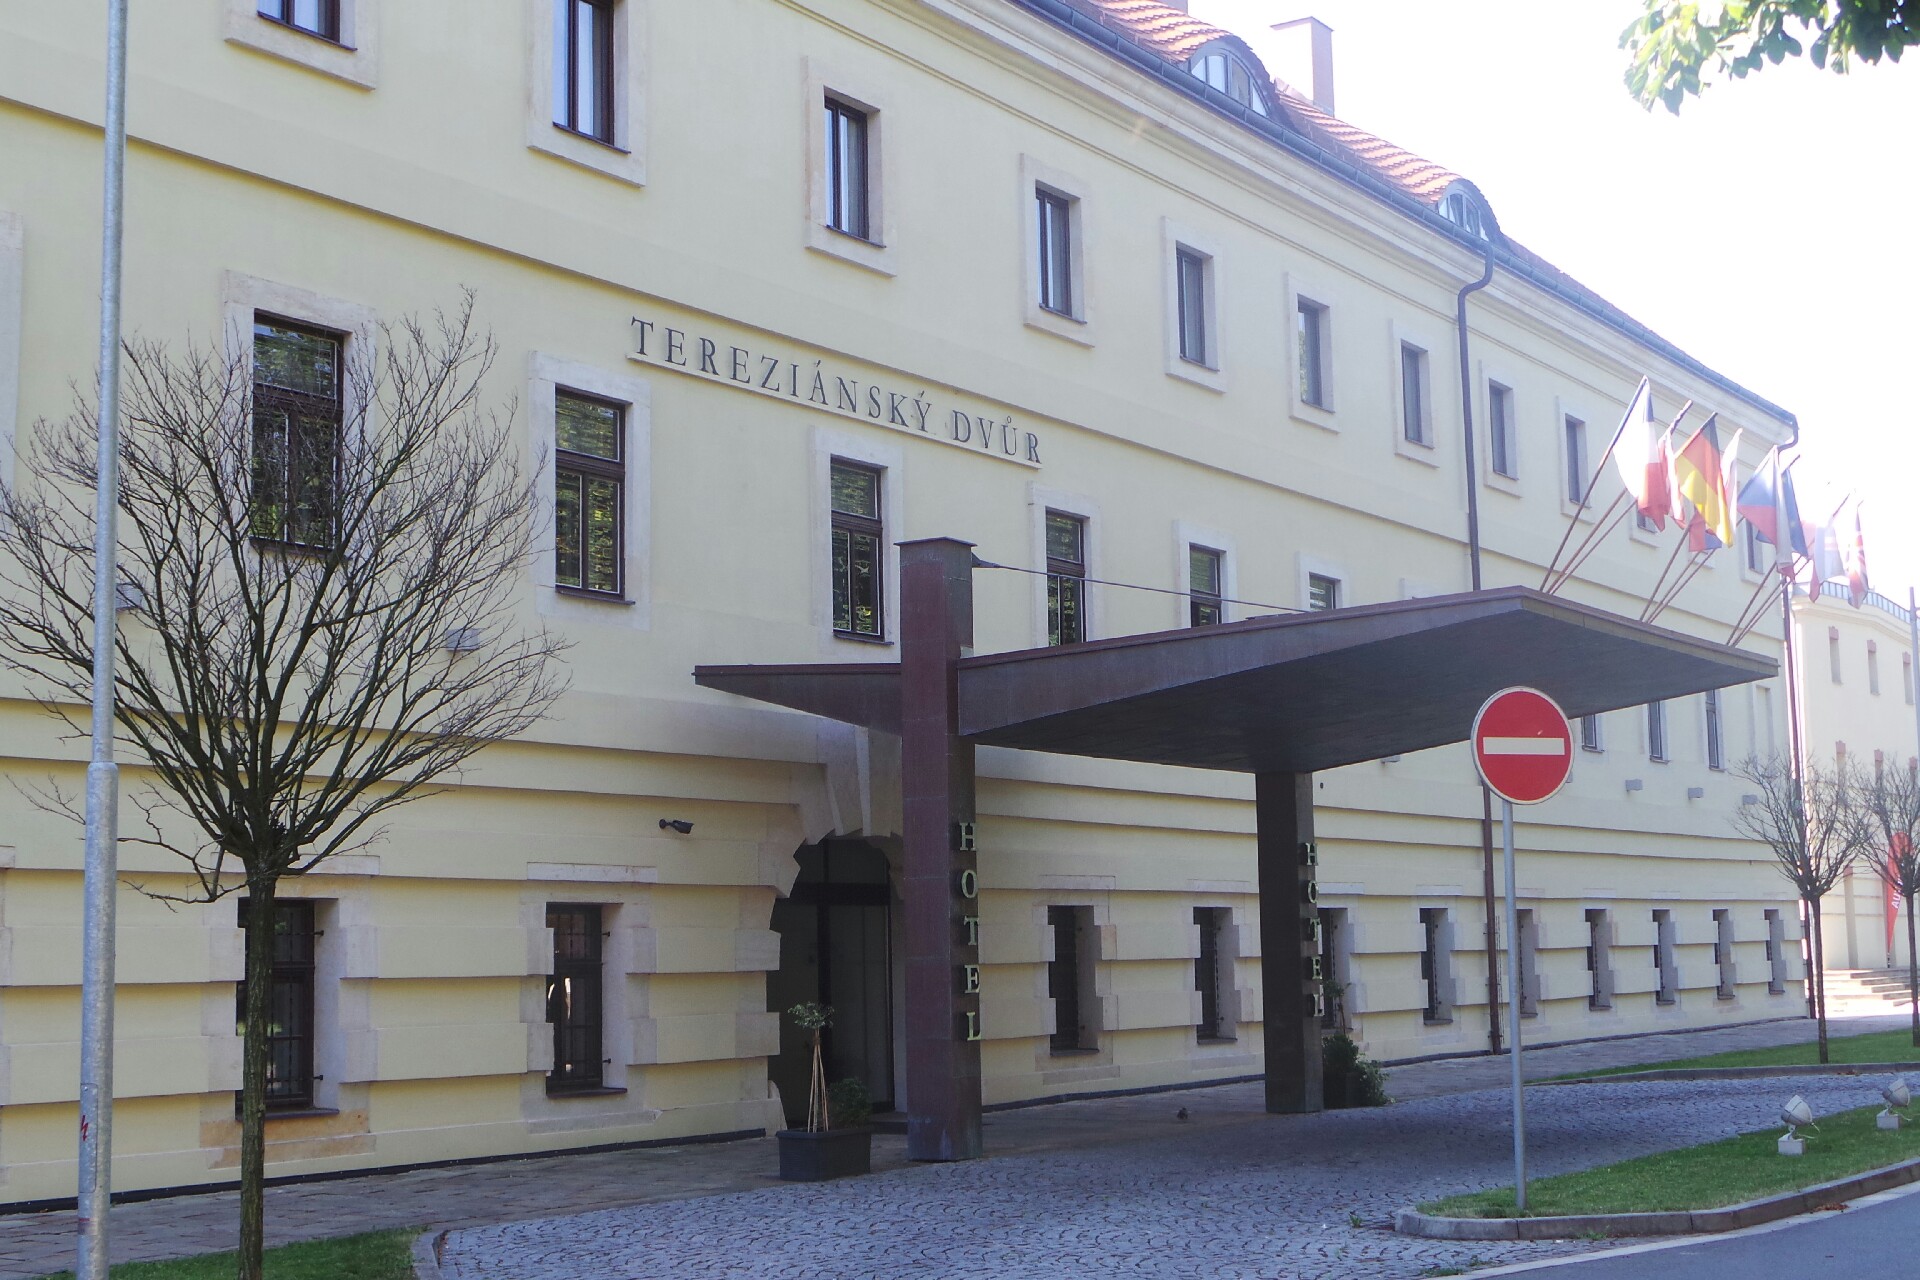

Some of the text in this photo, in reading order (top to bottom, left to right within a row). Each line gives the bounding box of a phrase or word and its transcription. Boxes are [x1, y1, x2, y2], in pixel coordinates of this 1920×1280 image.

[630, 316, 1041, 464] TEREZIÁNSKÝ DVŮR
[959, 822, 982, 1041] HOTEL
[1305, 842, 1325, 1017] HOTEL
